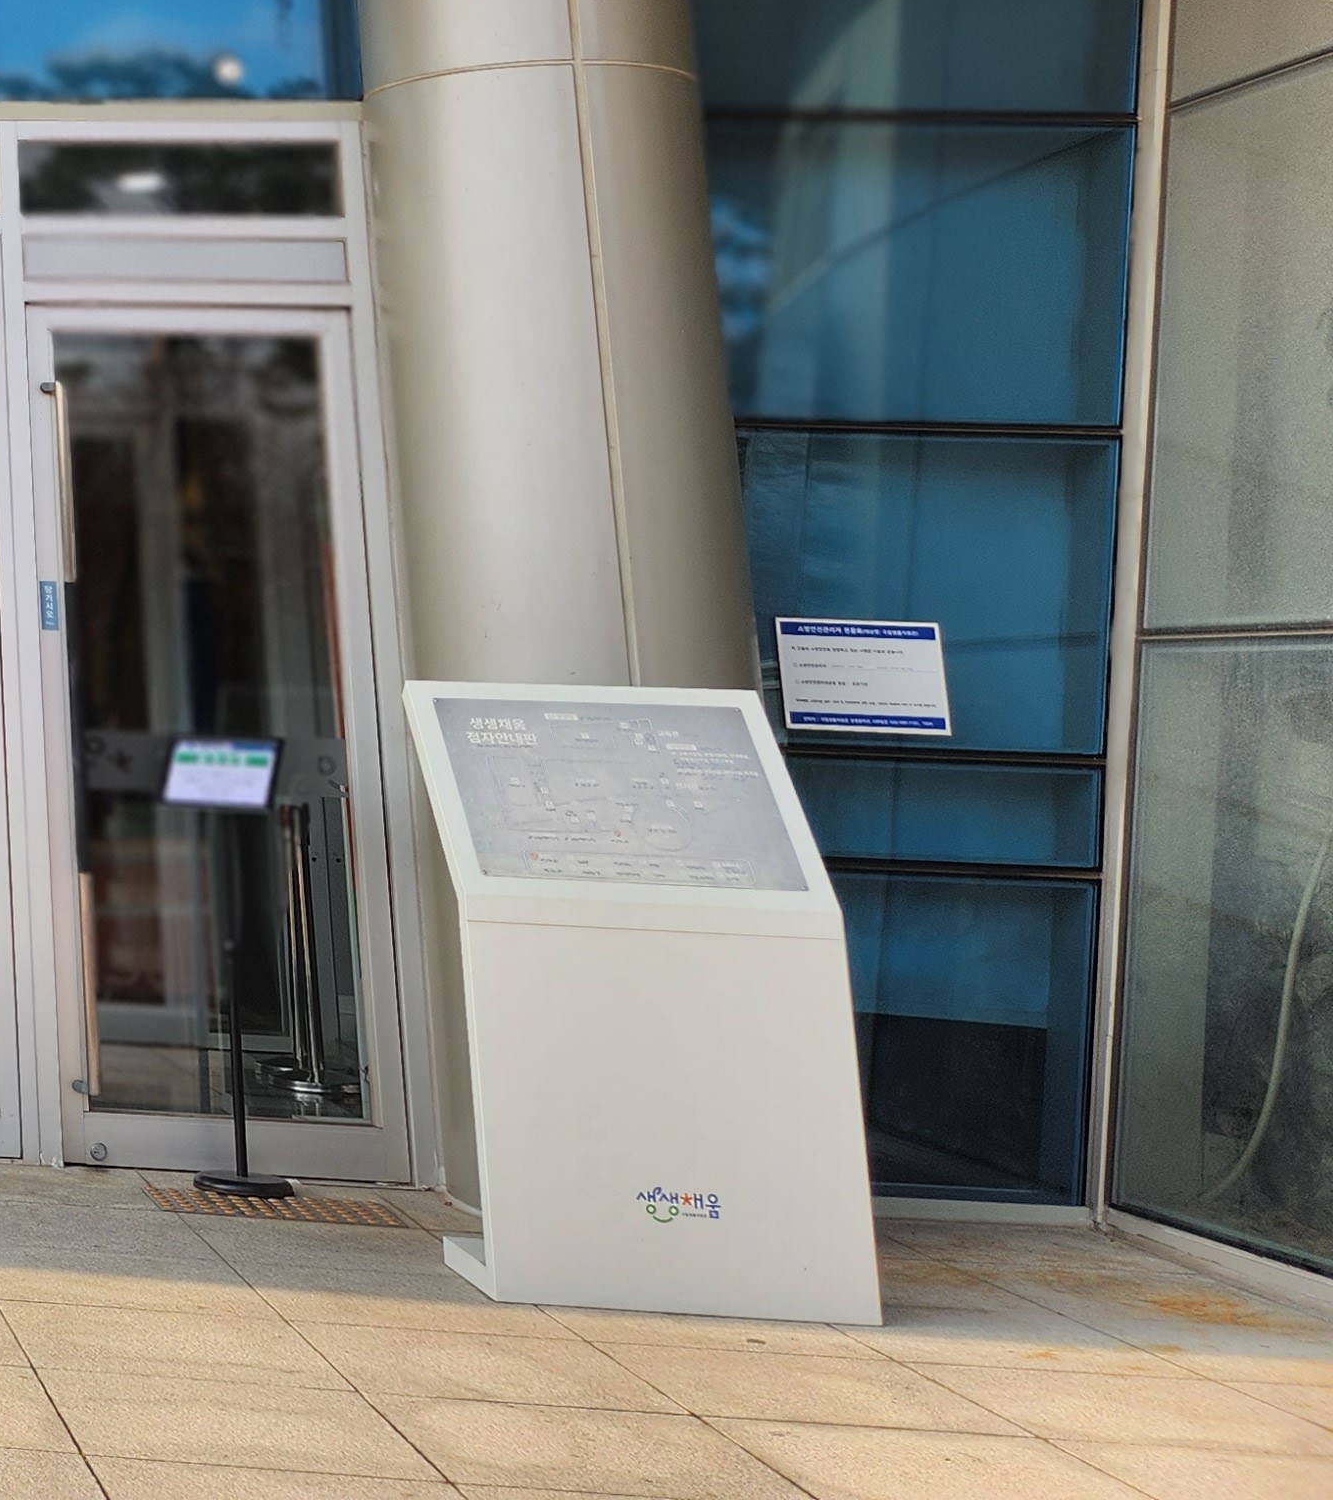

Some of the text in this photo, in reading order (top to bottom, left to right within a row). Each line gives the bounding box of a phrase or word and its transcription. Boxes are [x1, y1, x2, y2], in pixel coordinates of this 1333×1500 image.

[469, 717, 526, 731] 생생채움
[465, 731, 538, 746] 점자안내판
[636, 1186, 722, 1220] 생생채움
